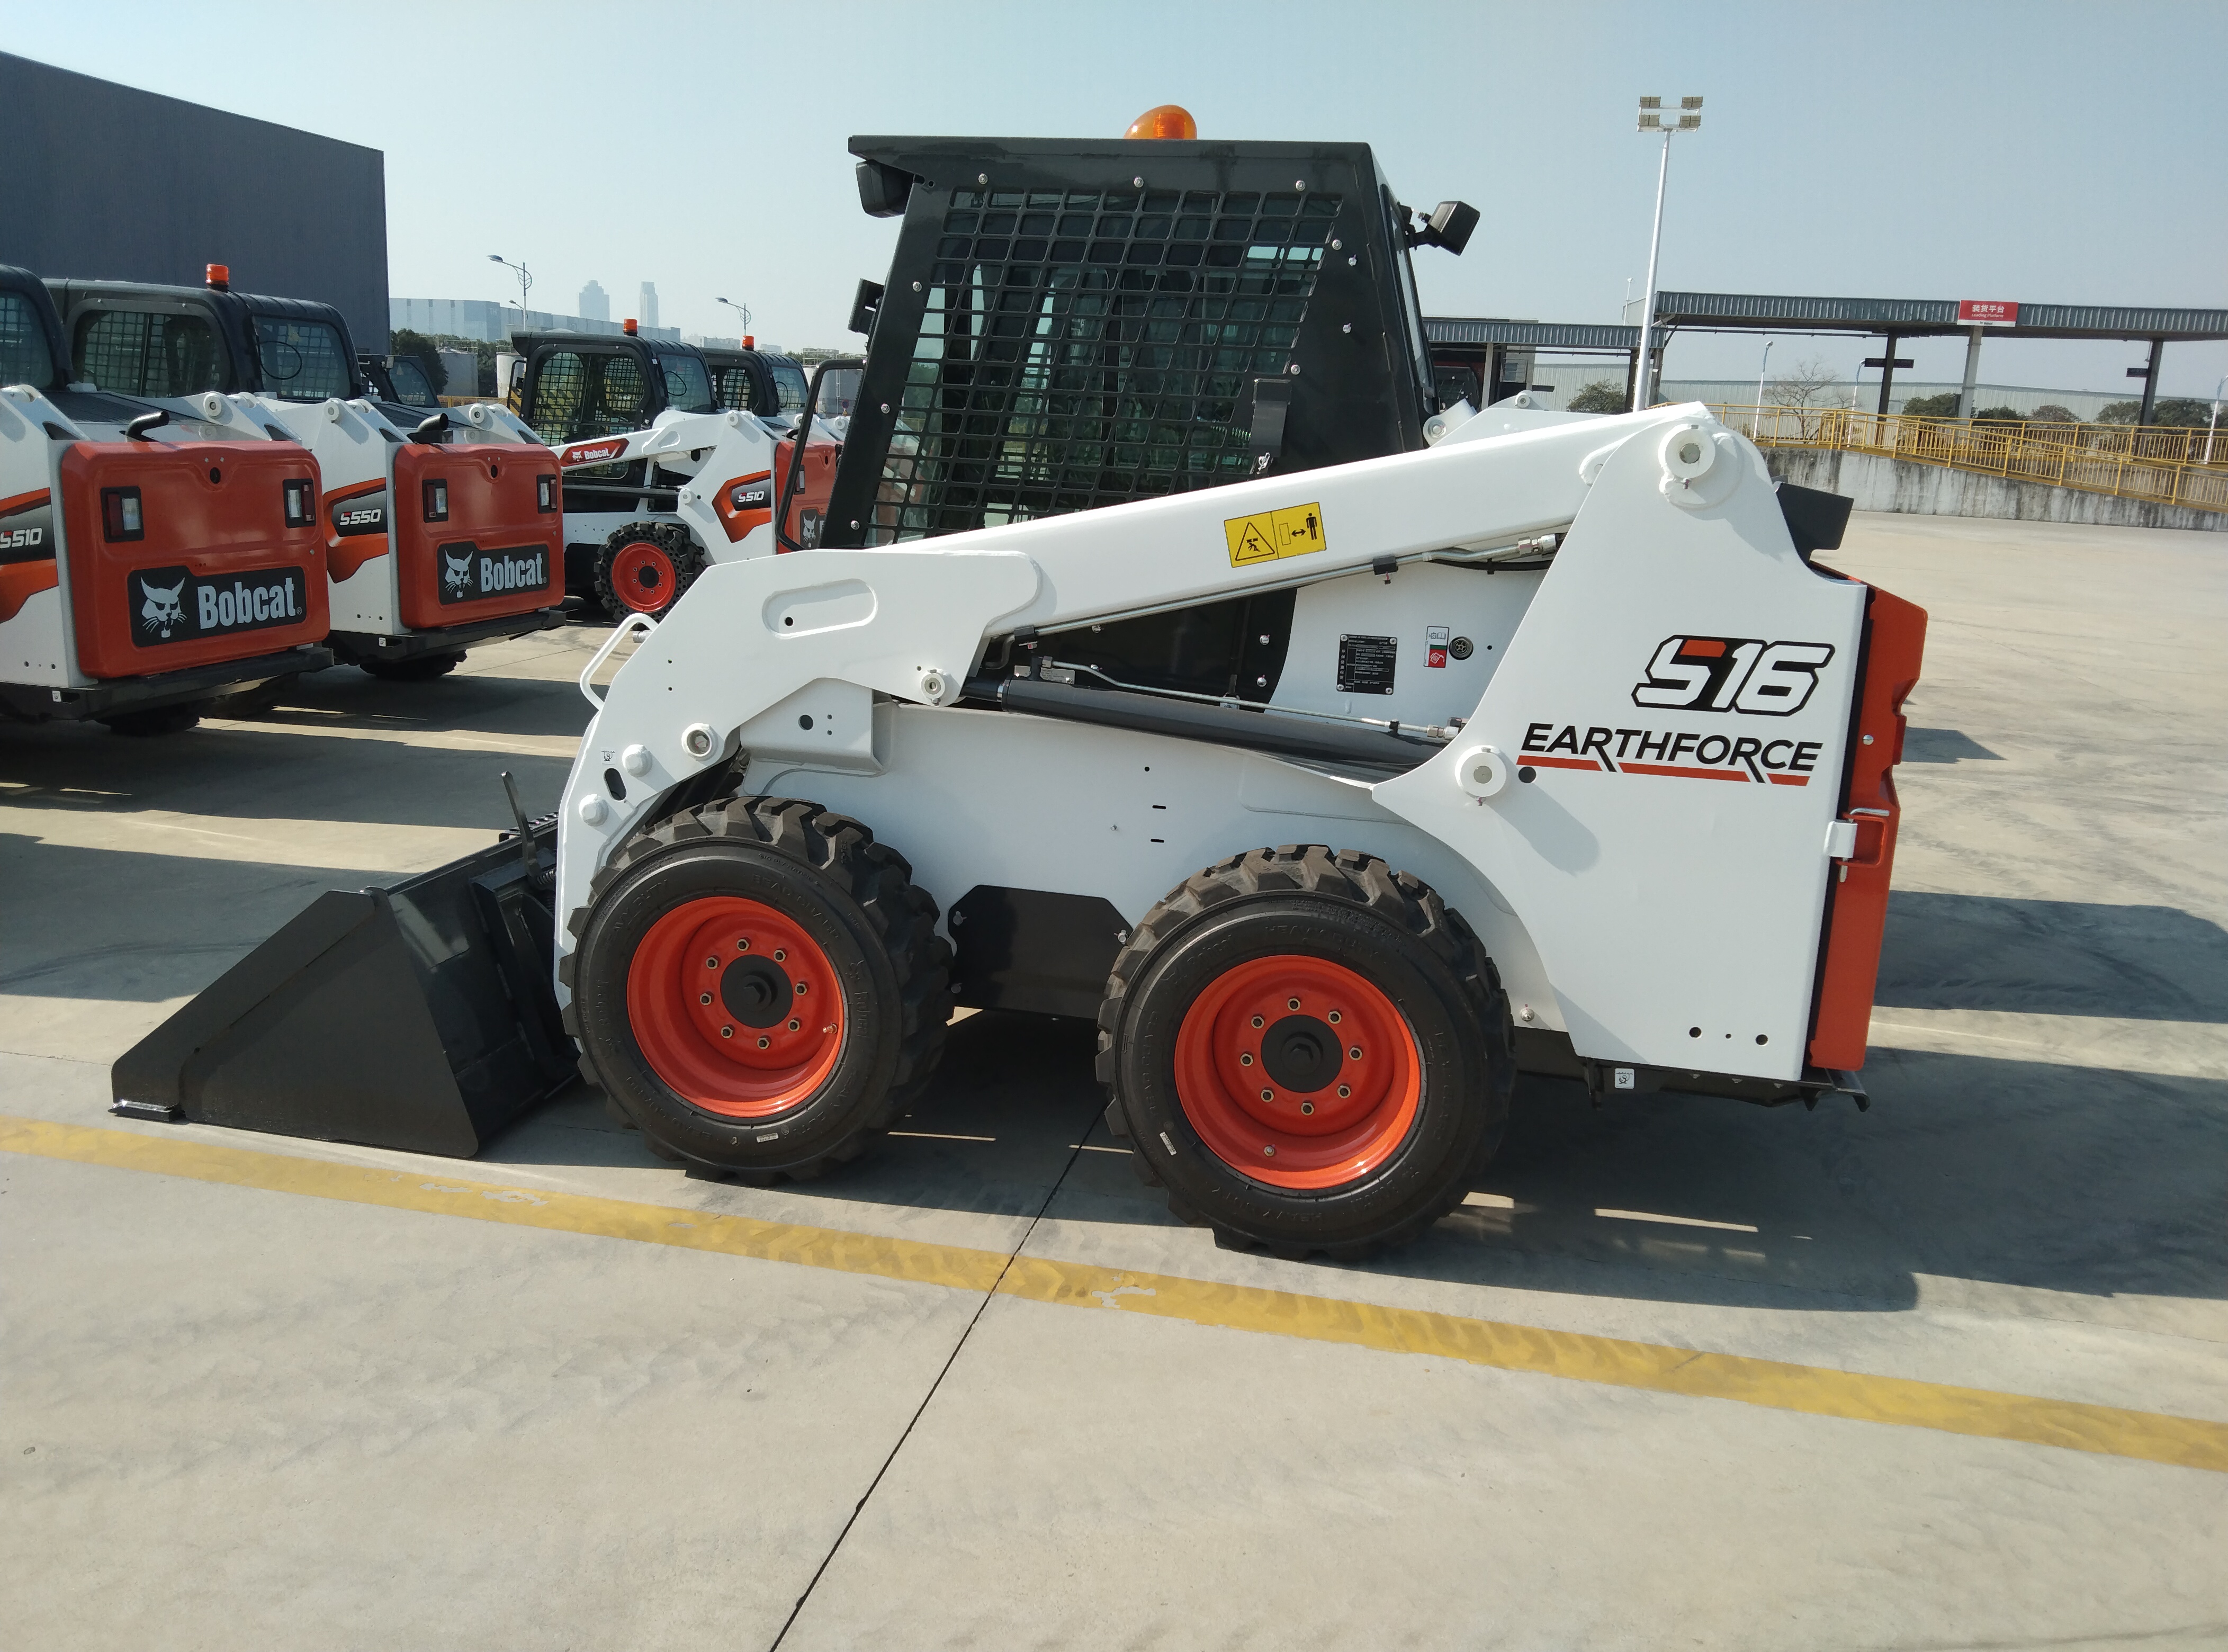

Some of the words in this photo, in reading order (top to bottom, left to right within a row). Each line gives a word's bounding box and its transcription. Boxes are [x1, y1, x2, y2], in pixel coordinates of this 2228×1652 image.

[1972, 304, 2005, 313] 装货平台
[584, 447, 609, 460] Bobcat
[738, 490, 765, 502] S510
[339, 508, 382, 526] S550
[0, 527, 42, 549] S510
[480, 552, 543, 592] Bobcat
[197, 577, 297, 630] Bobcat
[1631, 634, 1835, 717] S16
[1521, 722, 1823, 784] EARTHFORCE
